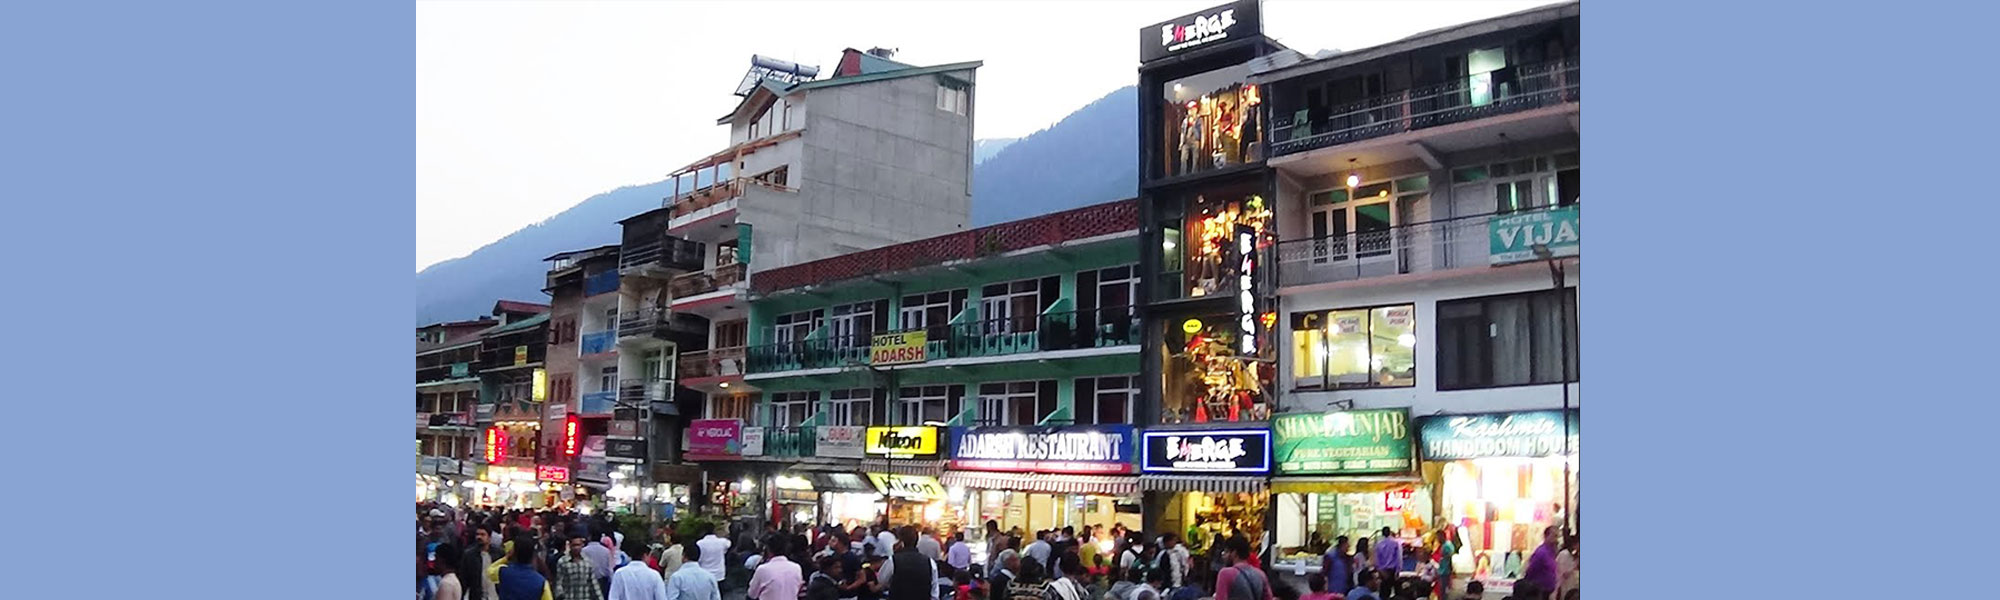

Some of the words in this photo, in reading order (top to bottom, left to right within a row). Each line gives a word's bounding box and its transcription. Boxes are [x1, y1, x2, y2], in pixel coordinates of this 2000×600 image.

[1499, 212, 1551, 226] HOTEL
[1496, 219, 1579, 250] VIJA
[872, 335, 907, 347] HOTEL
[872, 346, 925, 363] ADARSH
[1449, 415, 1554, 438] Kashmir
[878, 431, 922, 449] Nikon
[957, 432, 1015, 459] ADARSH
[1016, 432, 1123, 461] RESTAURANT
[1429, 437, 1521, 457] HANDLOOM
[879, 476, 936, 495] Nikon
